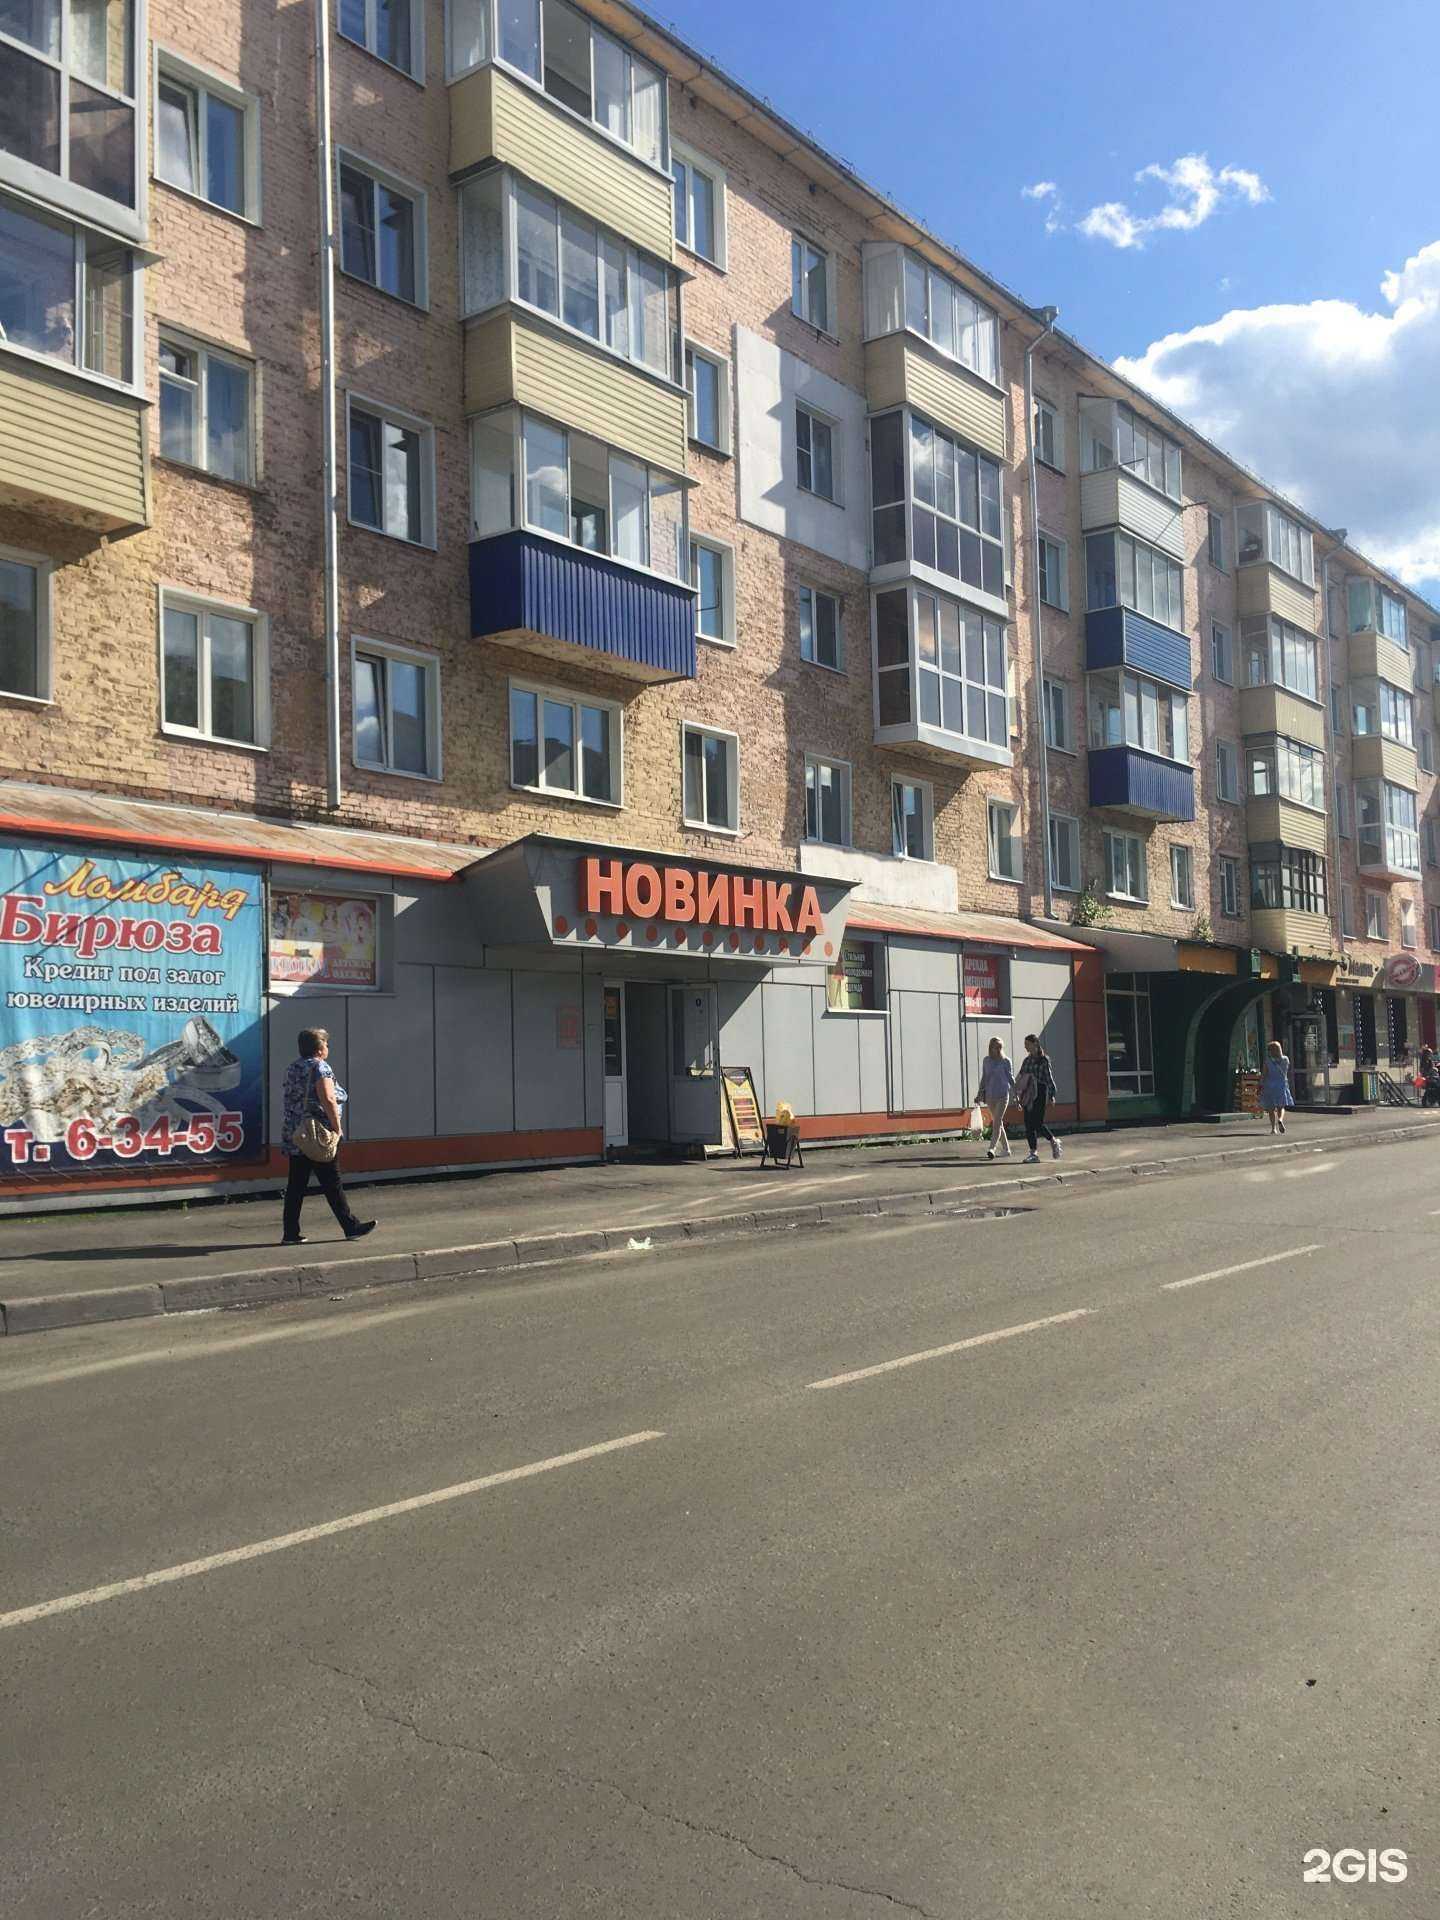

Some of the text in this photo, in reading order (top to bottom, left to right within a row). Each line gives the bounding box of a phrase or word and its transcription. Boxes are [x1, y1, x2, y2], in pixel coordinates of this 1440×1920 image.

[43, 858, 248, 919] Ломбард
[586, 857, 826, 935] НОВИНКА
[0, 894, 222, 958] Бирюза
[24, 956, 225, 985] Кредит под залог
[6, 992, 239, 1013] ювелирных изделий
[5, 1112, 244, 1163] т. 6-34-55
